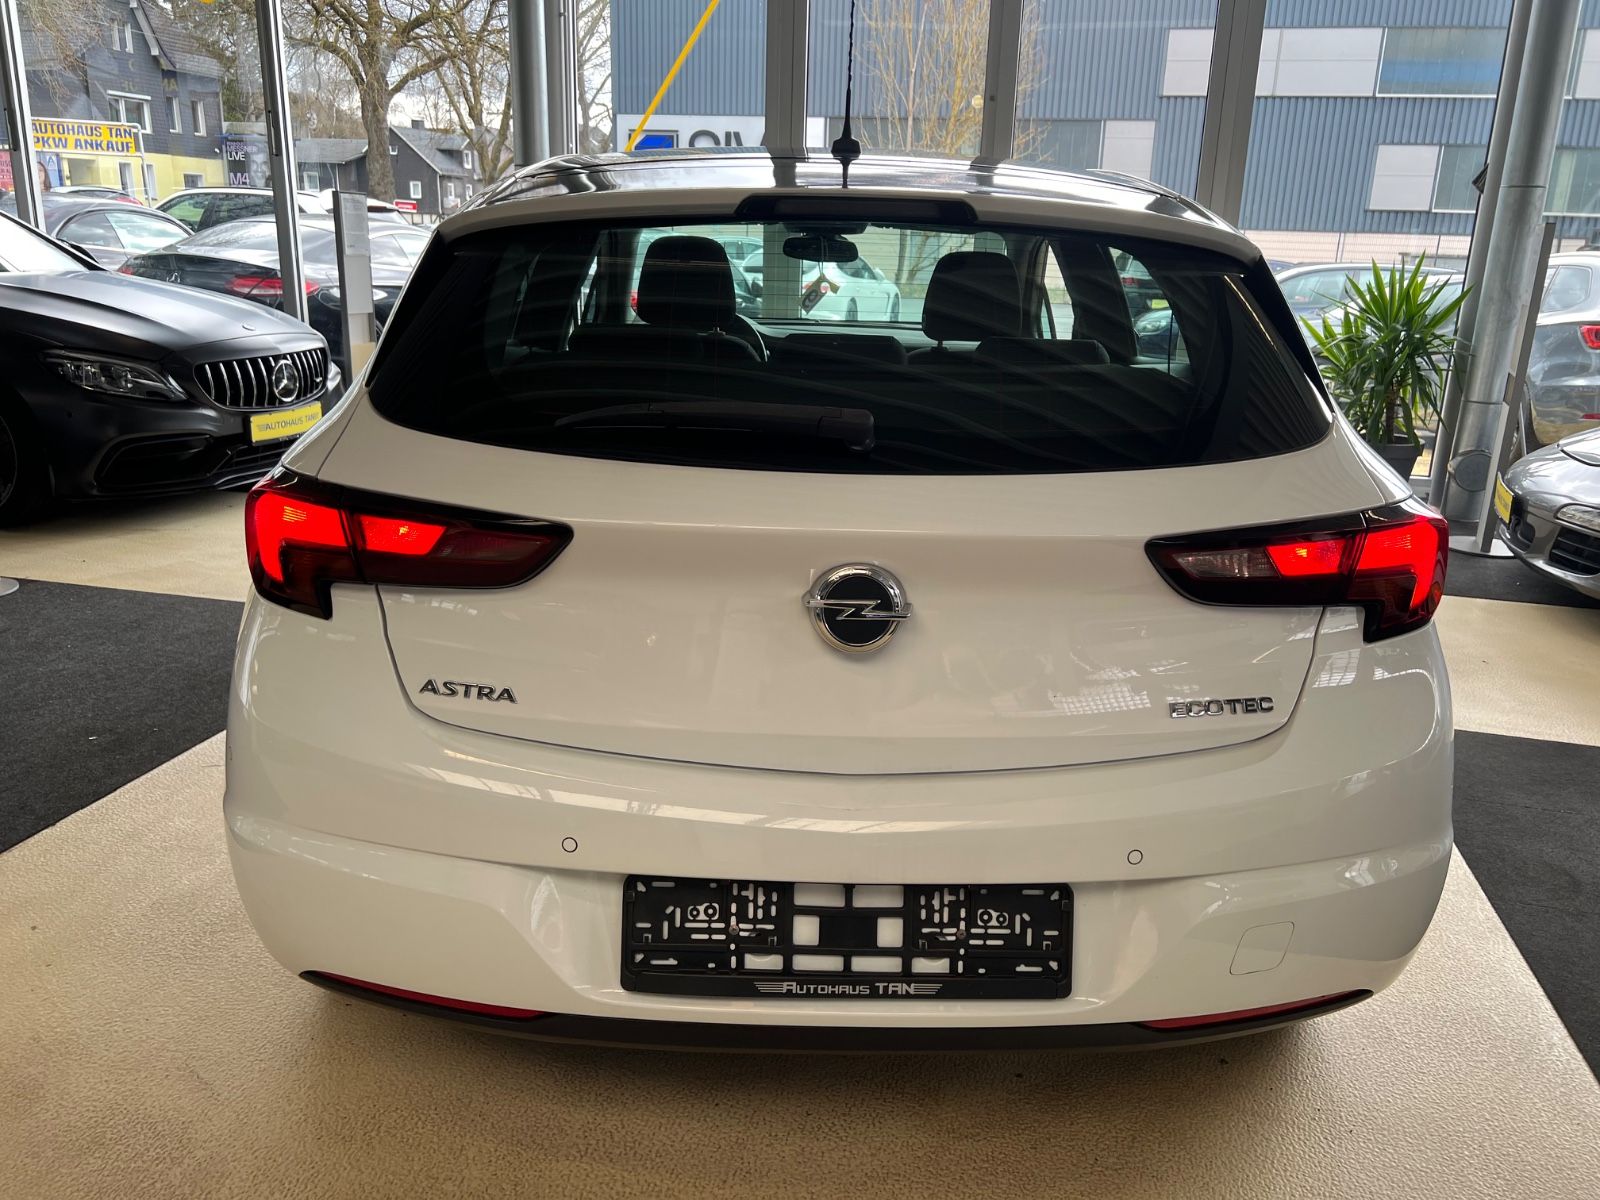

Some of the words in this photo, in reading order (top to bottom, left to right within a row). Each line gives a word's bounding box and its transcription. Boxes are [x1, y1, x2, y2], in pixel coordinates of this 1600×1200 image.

[32, 122, 102, 137] AUTOHAUS
[107, 127, 133, 139] TAN
[34, 136, 68, 149] PKW
[74, 138, 131, 152] ANKAUF
[228, 151, 246, 160] LIVE
[265, 416, 303, 431] AUTOHAUS
[419, 679, 518, 704] ASTRA
[1168, 697, 1275, 718] ECOTEC
[782, 981, 870, 995] AUTOHAUS
[875, 983, 914, 995] TAN
